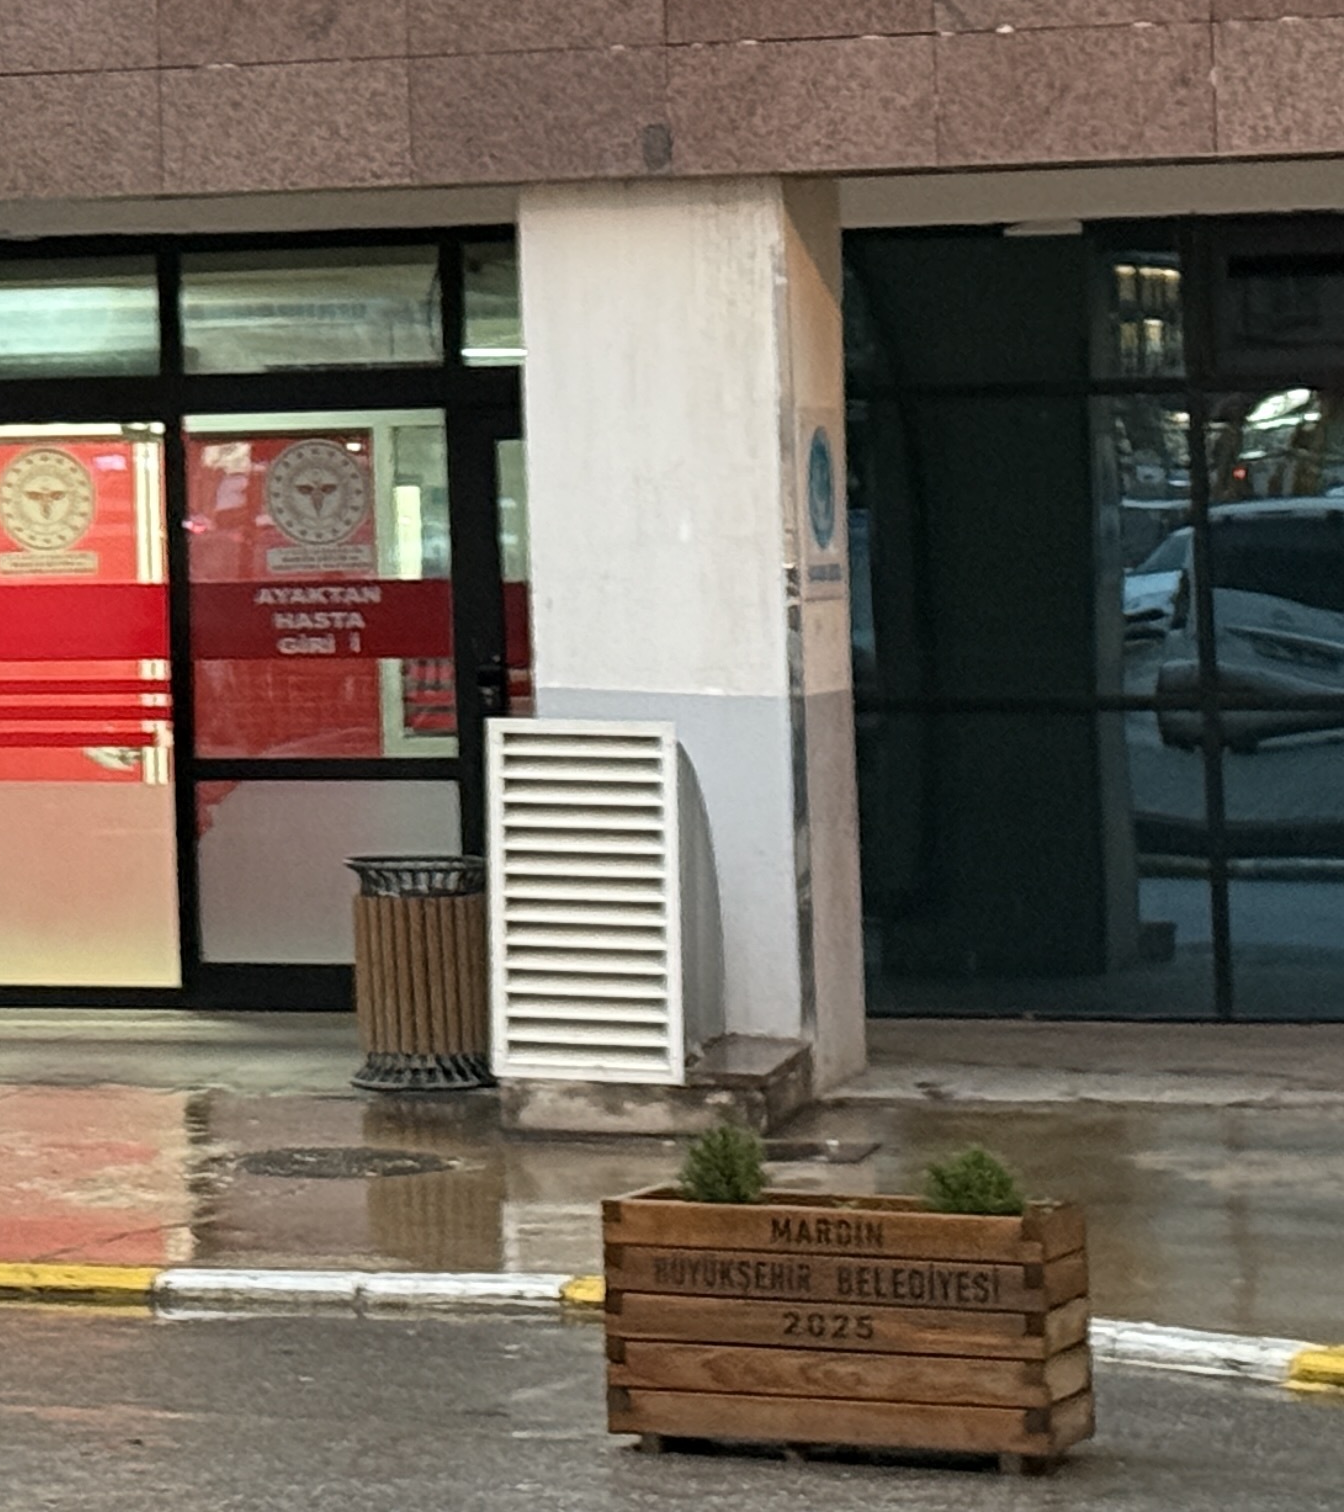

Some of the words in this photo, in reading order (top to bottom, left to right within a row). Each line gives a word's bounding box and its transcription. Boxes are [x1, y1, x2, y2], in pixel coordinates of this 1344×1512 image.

[253, 585, 382, 605] AYAKTAN
[273, 611, 366, 630] HASTA
[781, 1310, 875, 1340] 2025
